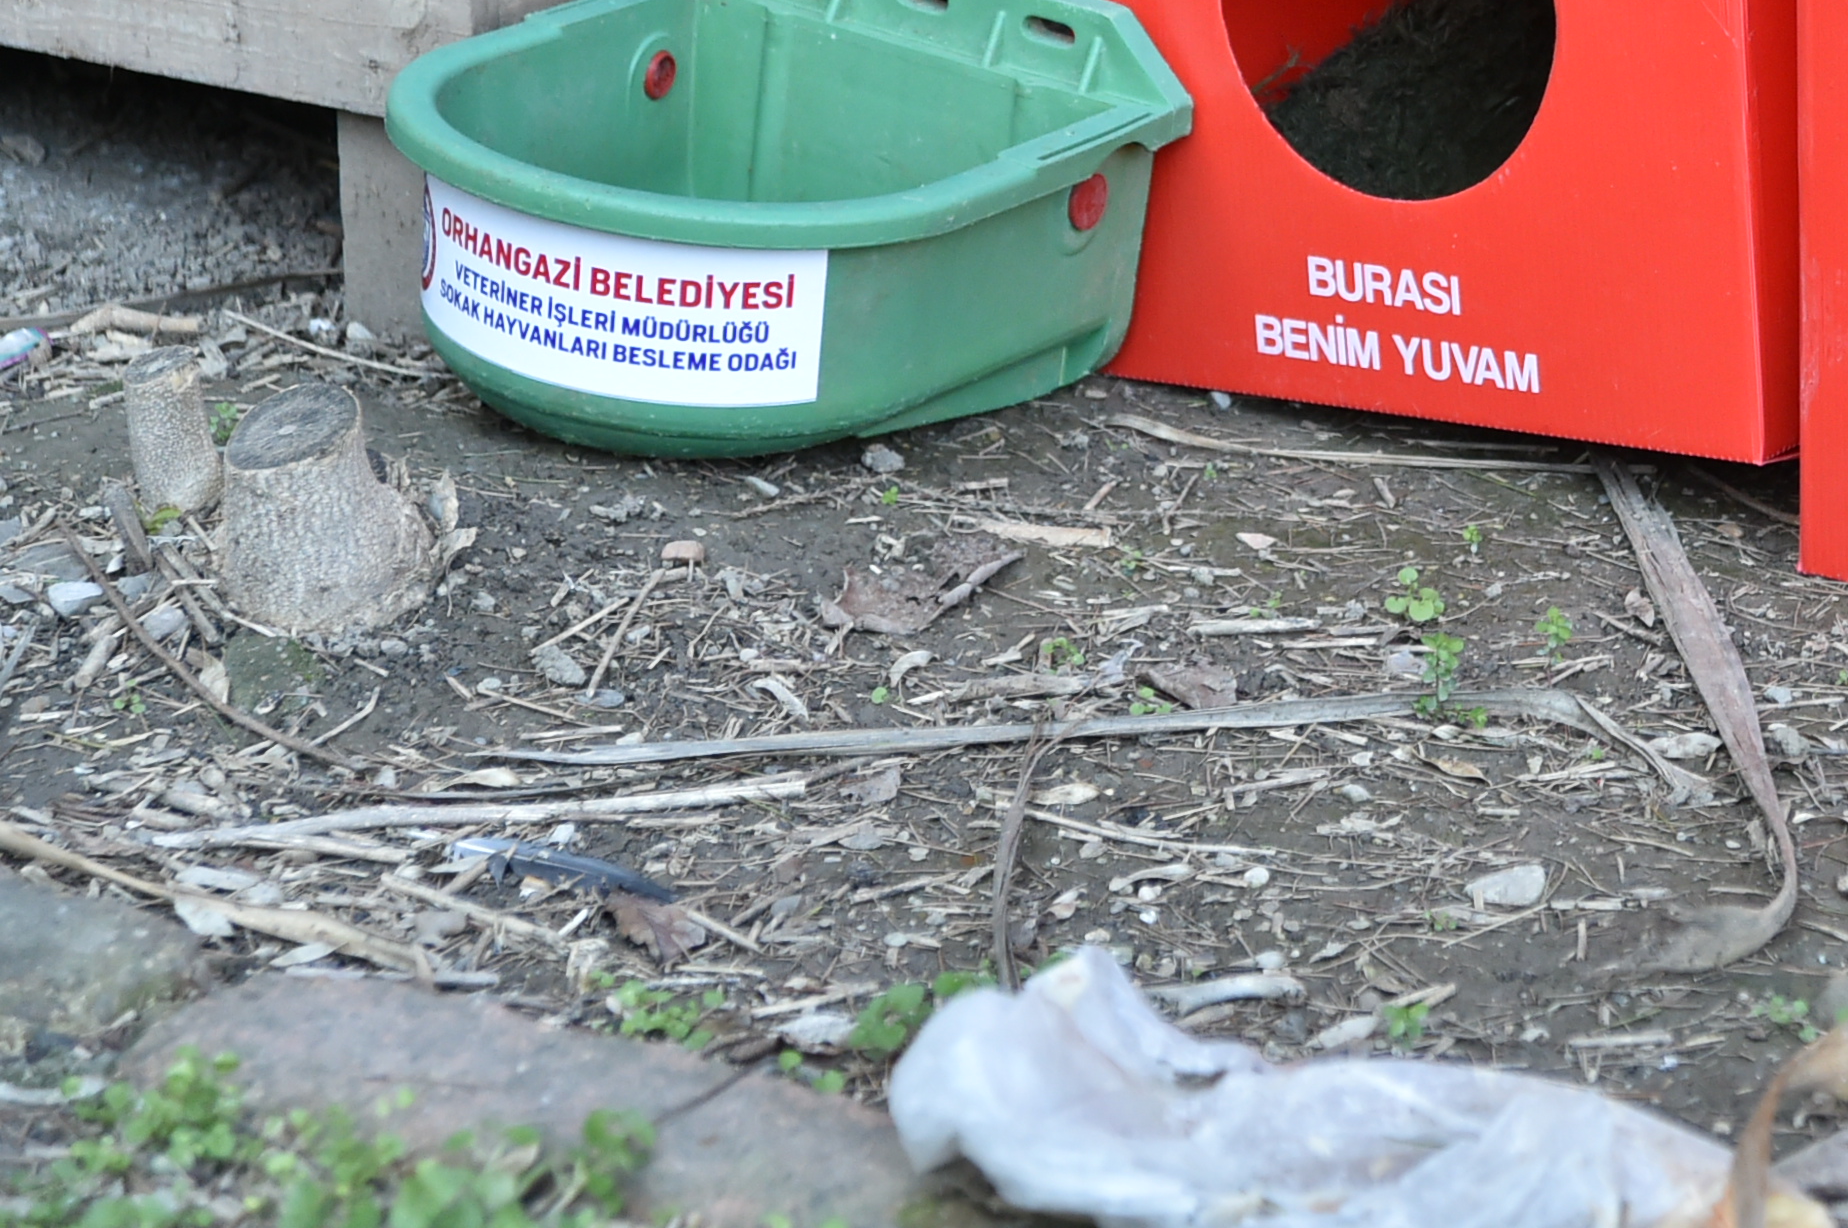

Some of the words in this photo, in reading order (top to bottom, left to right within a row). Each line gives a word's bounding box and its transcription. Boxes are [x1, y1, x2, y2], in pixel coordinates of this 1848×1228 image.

[442, 206, 581, 291] ORHANGAZİ
[589, 265, 796, 310] BELEDİYESİ
[1307, 255, 1462, 316] BURASI
[439, 279, 480, 322] SOKAK
[483, 310, 607, 360] HAYVANLARI
[612, 344, 722, 372] BESLEME
[728, 347, 797, 372] ODAĞI
[455, 259, 543, 316] VETERİNER
[548, 296, 616, 333] İŞLERİ
[621, 315, 770, 344] MÜDÜRLÜĞÜ
[1254, 314, 1381, 371] BENİM
[1392, 334, 1541, 394] YUVAM
